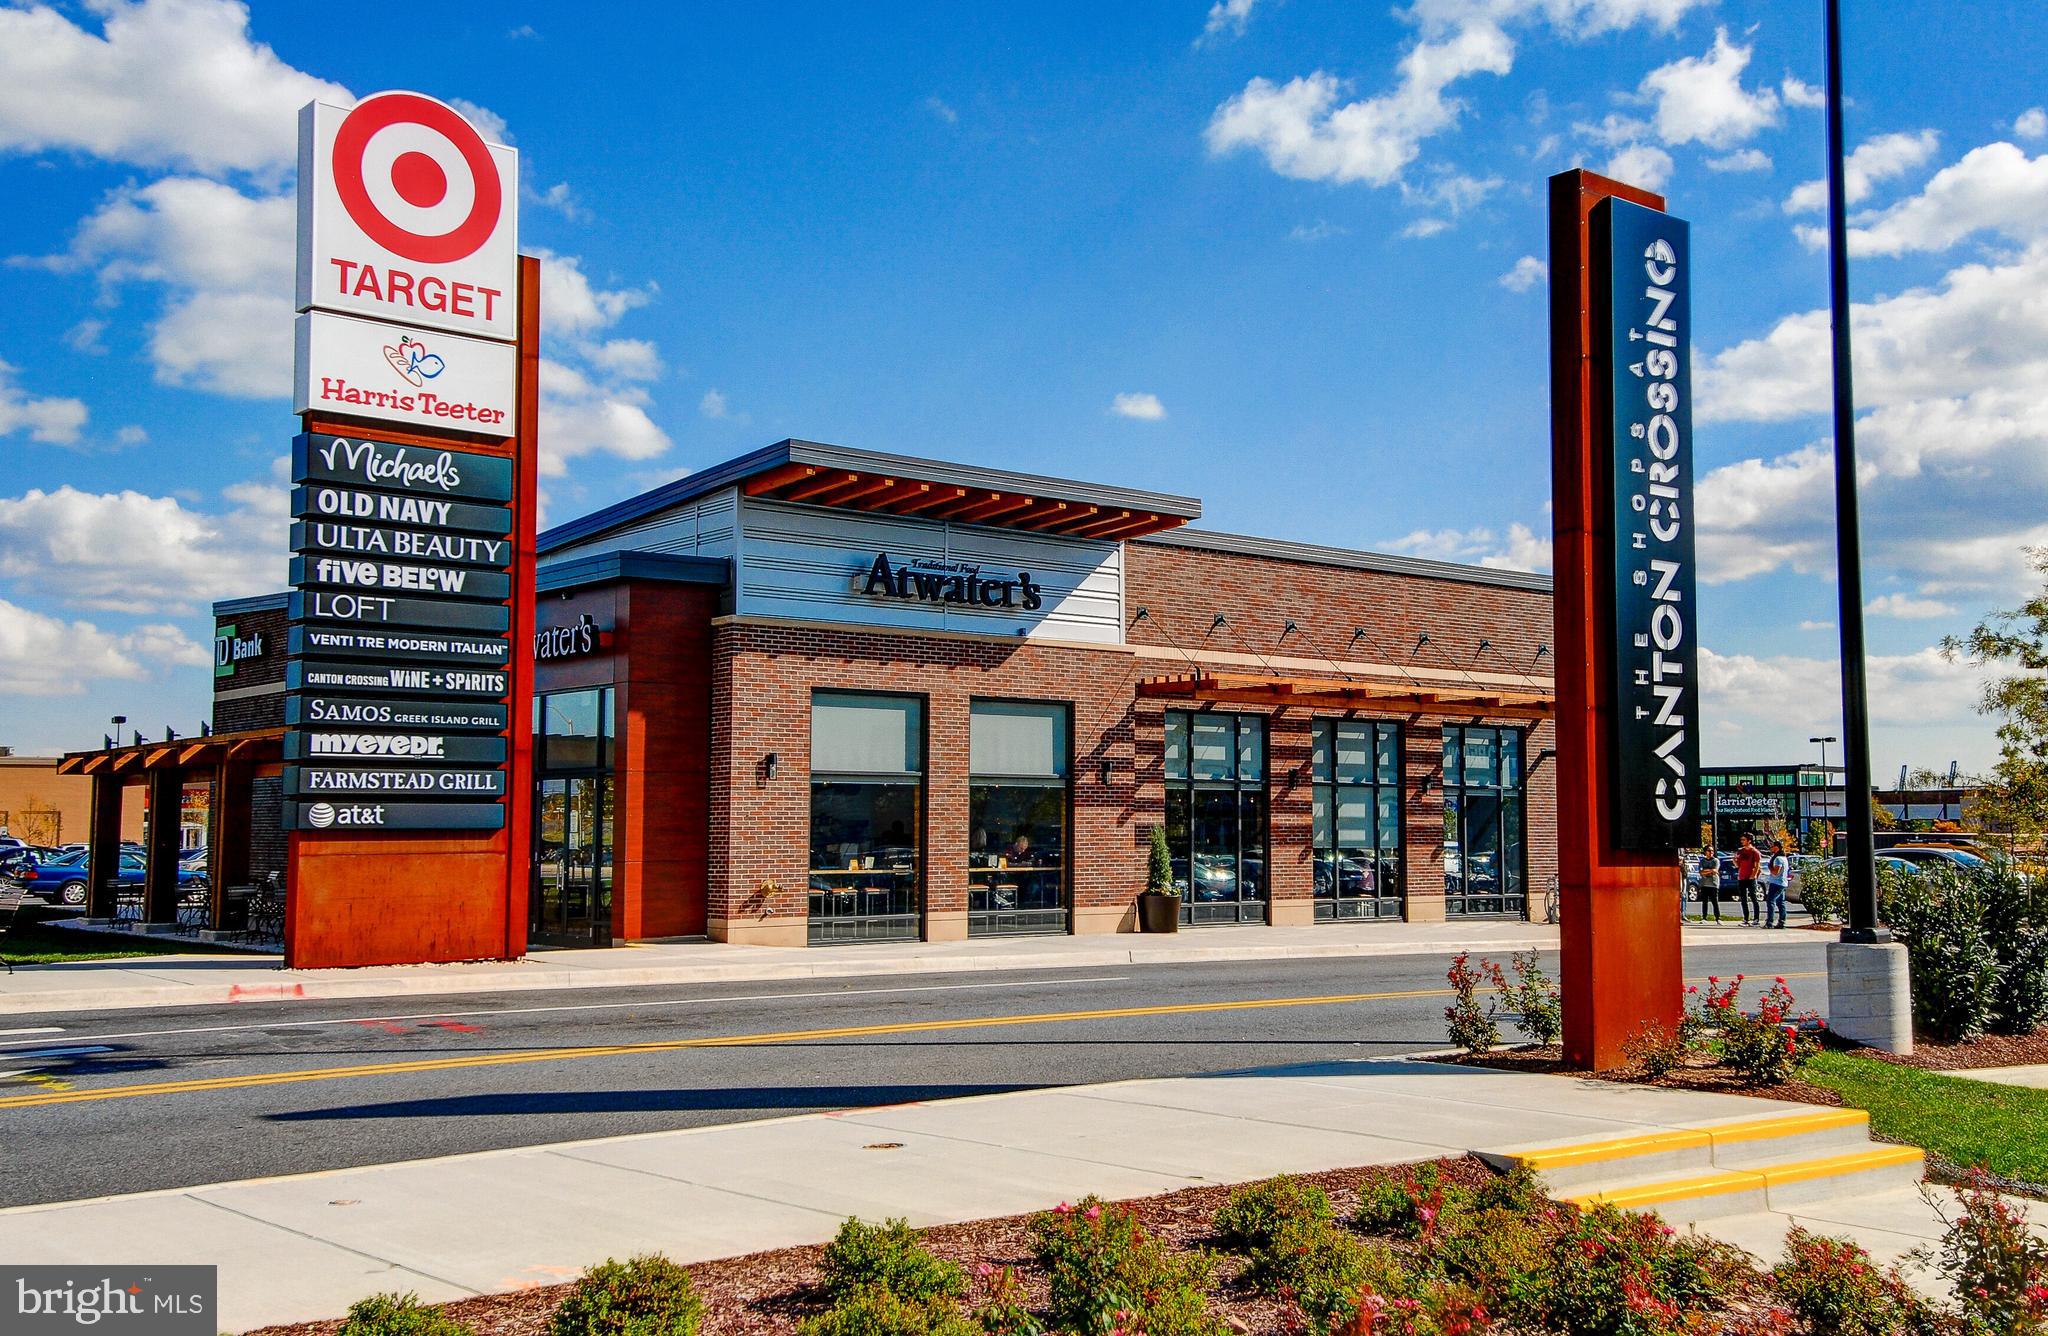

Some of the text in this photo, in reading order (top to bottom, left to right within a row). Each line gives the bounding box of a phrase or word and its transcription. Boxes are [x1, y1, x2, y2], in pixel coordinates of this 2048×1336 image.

[330, 258, 501, 321] TARGET
[320, 377, 505, 424] Harris Teeter
[319, 437, 461, 491] Michaels
[318, 489, 453, 525] OLD NAVY
[1629, 327, 1650, 720] THE SHOPS AT
[317, 523, 502, 562] ULTA BEAUTY
[1645, 238, 1686, 821] CANTON CROSSING
[317, 558, 466, 593] five BELOW
[861, 551, 1043, 611] Atwater's
[315, 593, 396, 621] LOFT
[233, 633, 263, 660] Bank
[310, 633, 354, 647] VENTI
[357, 636, 385, 649] TRE
[388, 638, 448, 652] MODERN
[307, 672, 344, 685] CANTON
[344, 674, 389, 687] CROSSING
[390, 669, 430, 688] WINE
[445, 672, 504, 692] SPIRITS
[310, 699, 500, 726] SAMOS GREEK ISLAND GRILL
[309, 770, 497, 791] FARMSTEAD GRILL
[337, 804, 385, 825] at&t
[1745, 796, 1778, 806] Teeter
